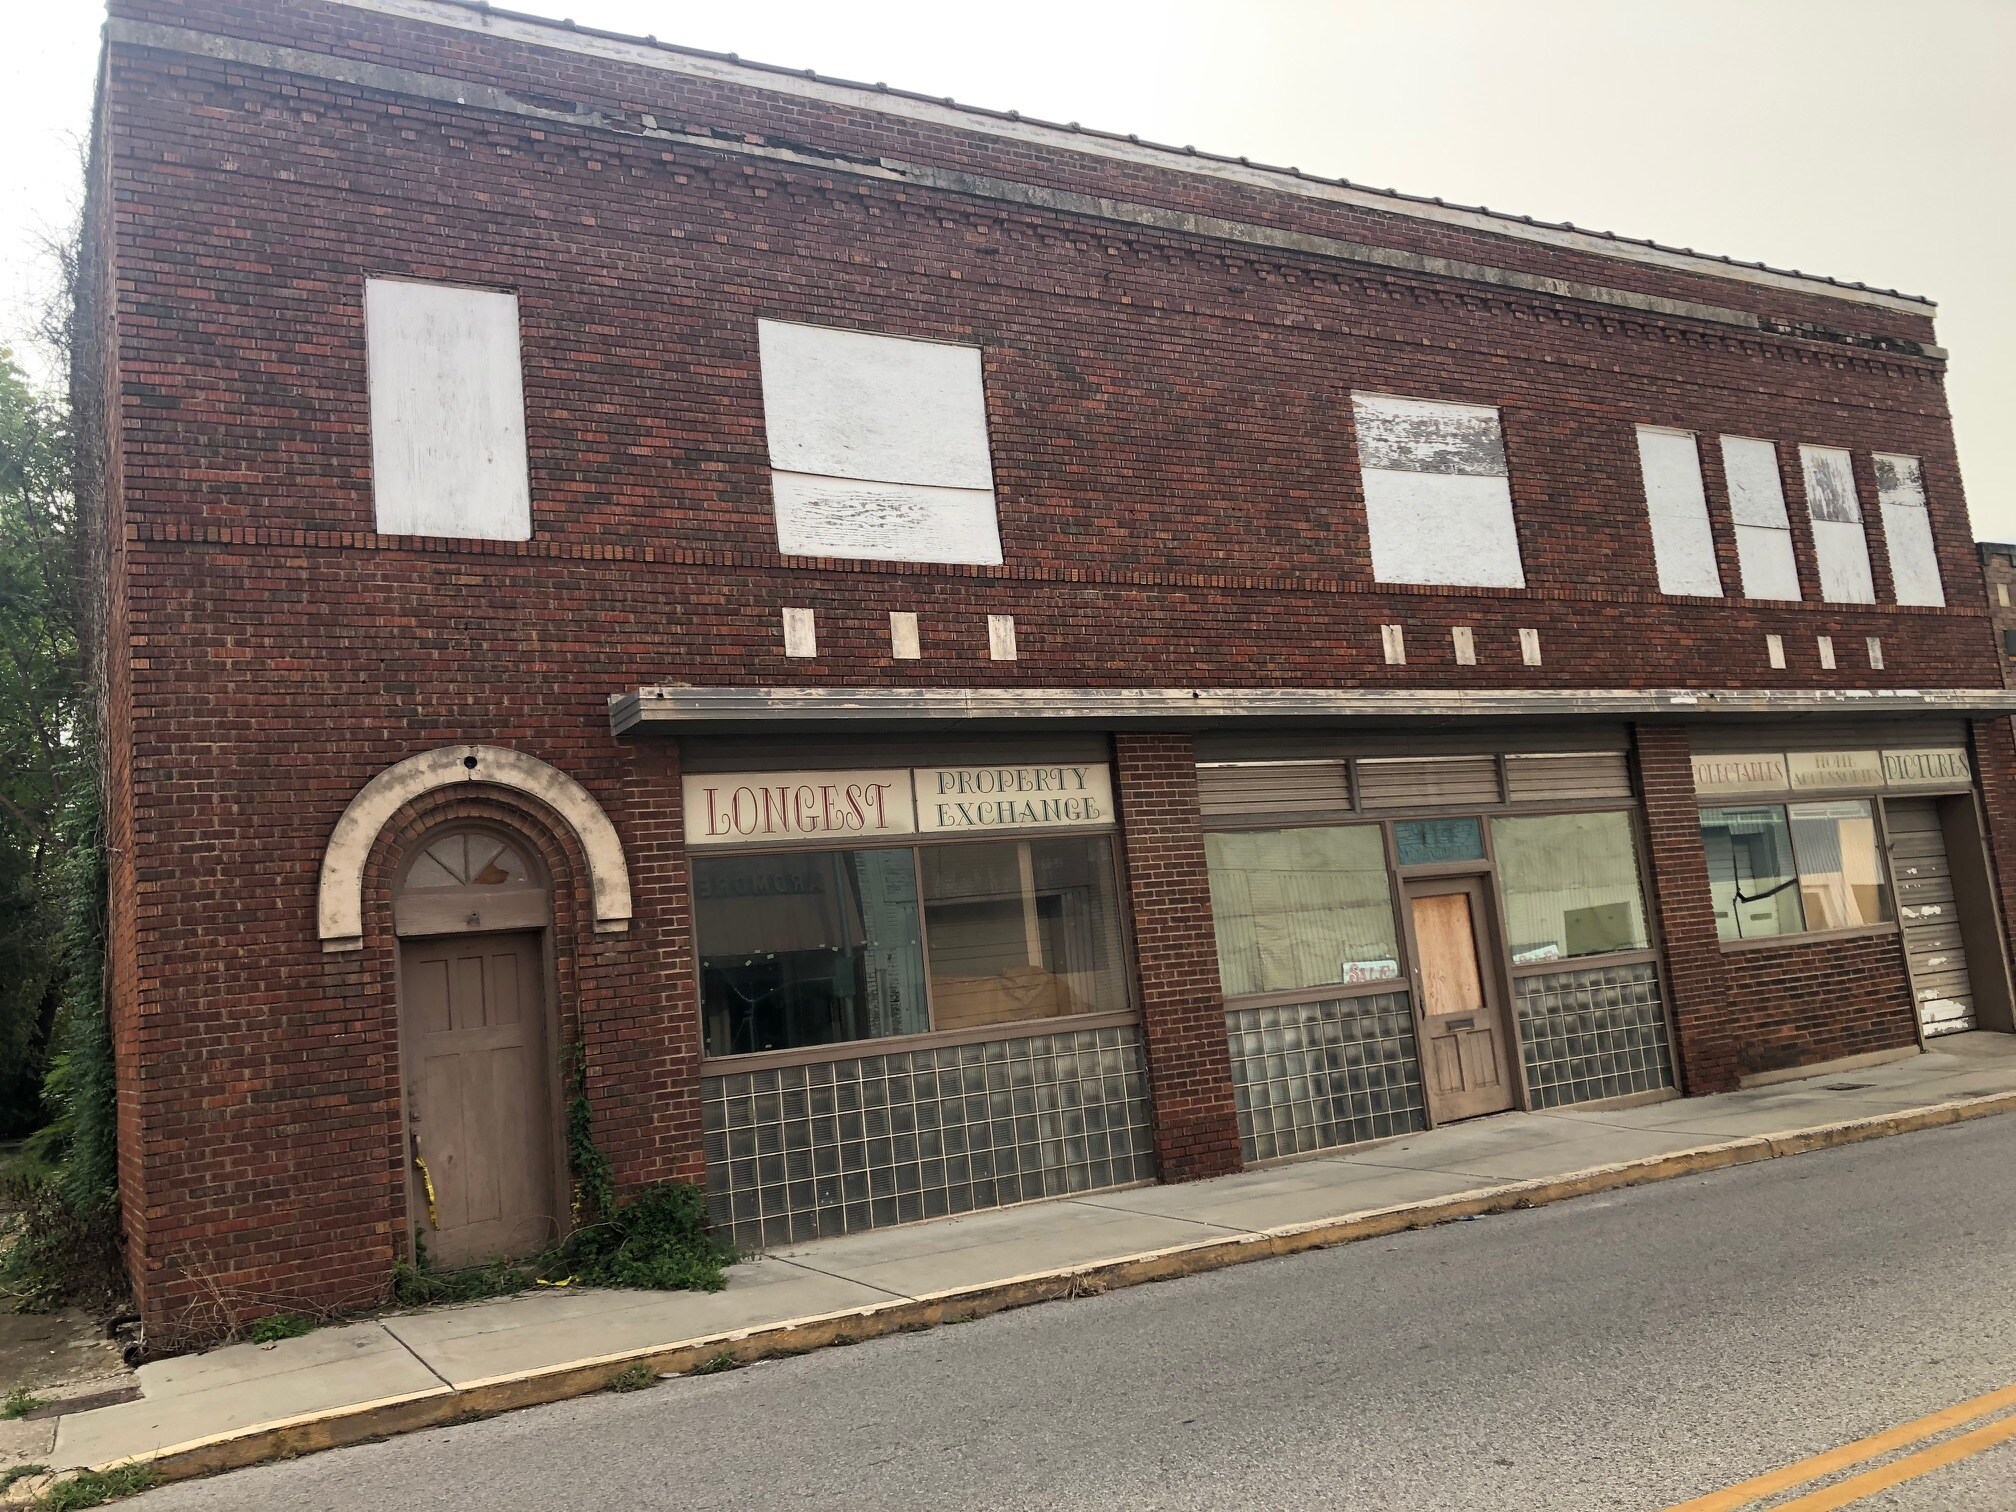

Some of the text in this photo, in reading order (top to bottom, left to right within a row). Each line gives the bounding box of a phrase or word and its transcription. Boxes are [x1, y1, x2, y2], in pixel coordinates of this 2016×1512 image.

[935, 767, 1091, 796] PROPERTY
[1885, 753, 1970, 780] PICTURES
[703, 783, 892, 836] LONGEST
[935, 796, 1101, 828] EXCHANGE
